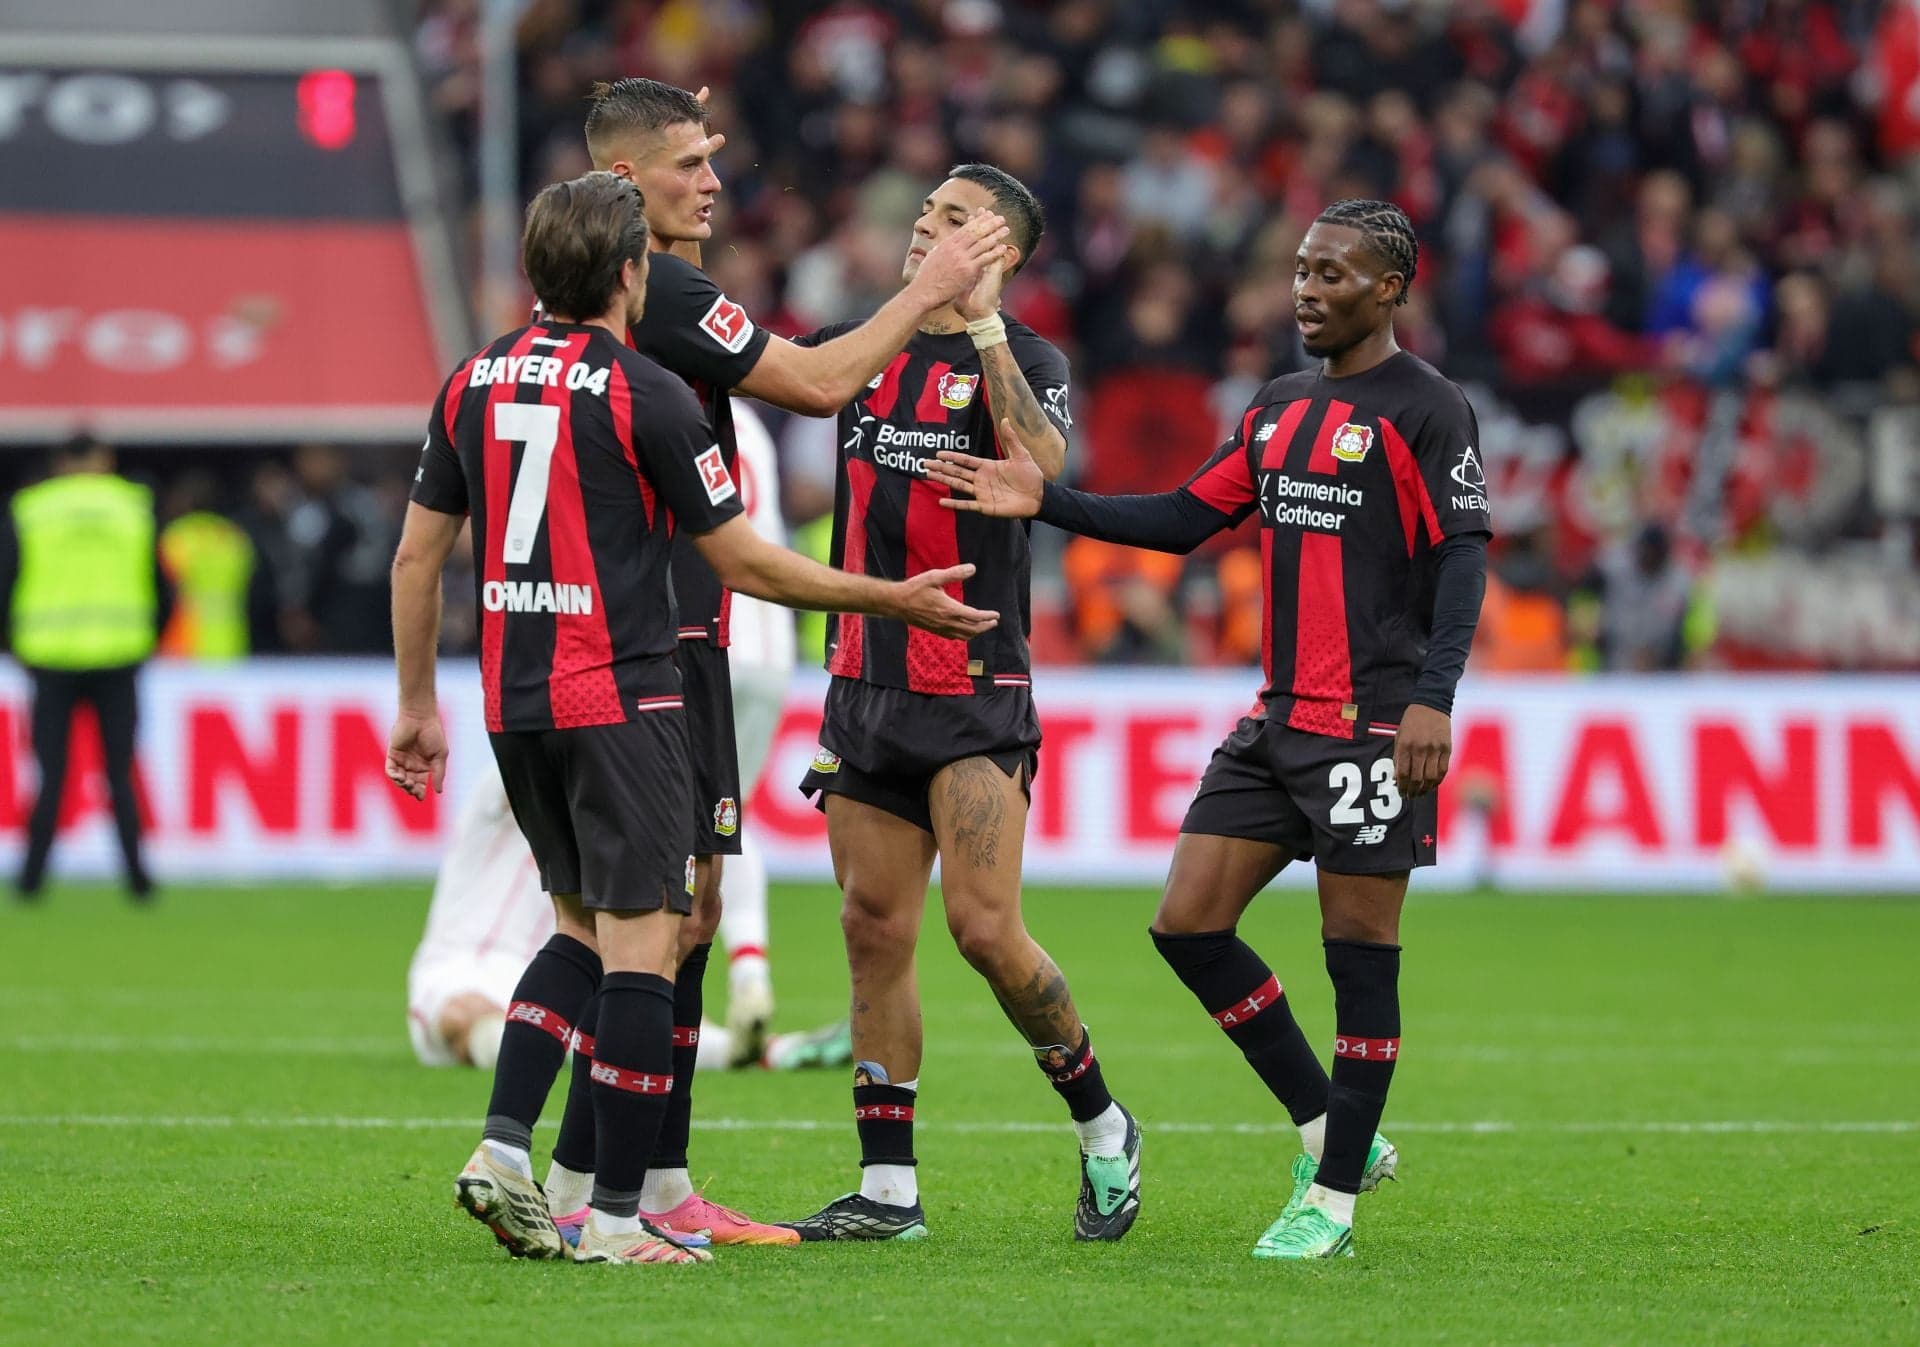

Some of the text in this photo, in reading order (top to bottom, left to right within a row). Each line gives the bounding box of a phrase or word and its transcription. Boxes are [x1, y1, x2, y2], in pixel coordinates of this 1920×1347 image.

[469, 356, 610, 396] BAYER 04
[877, 424, 970, 450] Barmenia
[494, 403, 561, 564] 7
[1278, 475, 1363, 506] Barmenia
[1276, 503, 1345, 530] Gothaer
[1329, 757, 1402, 825] 23
[1335, 1039, 1368, 1058] 04
